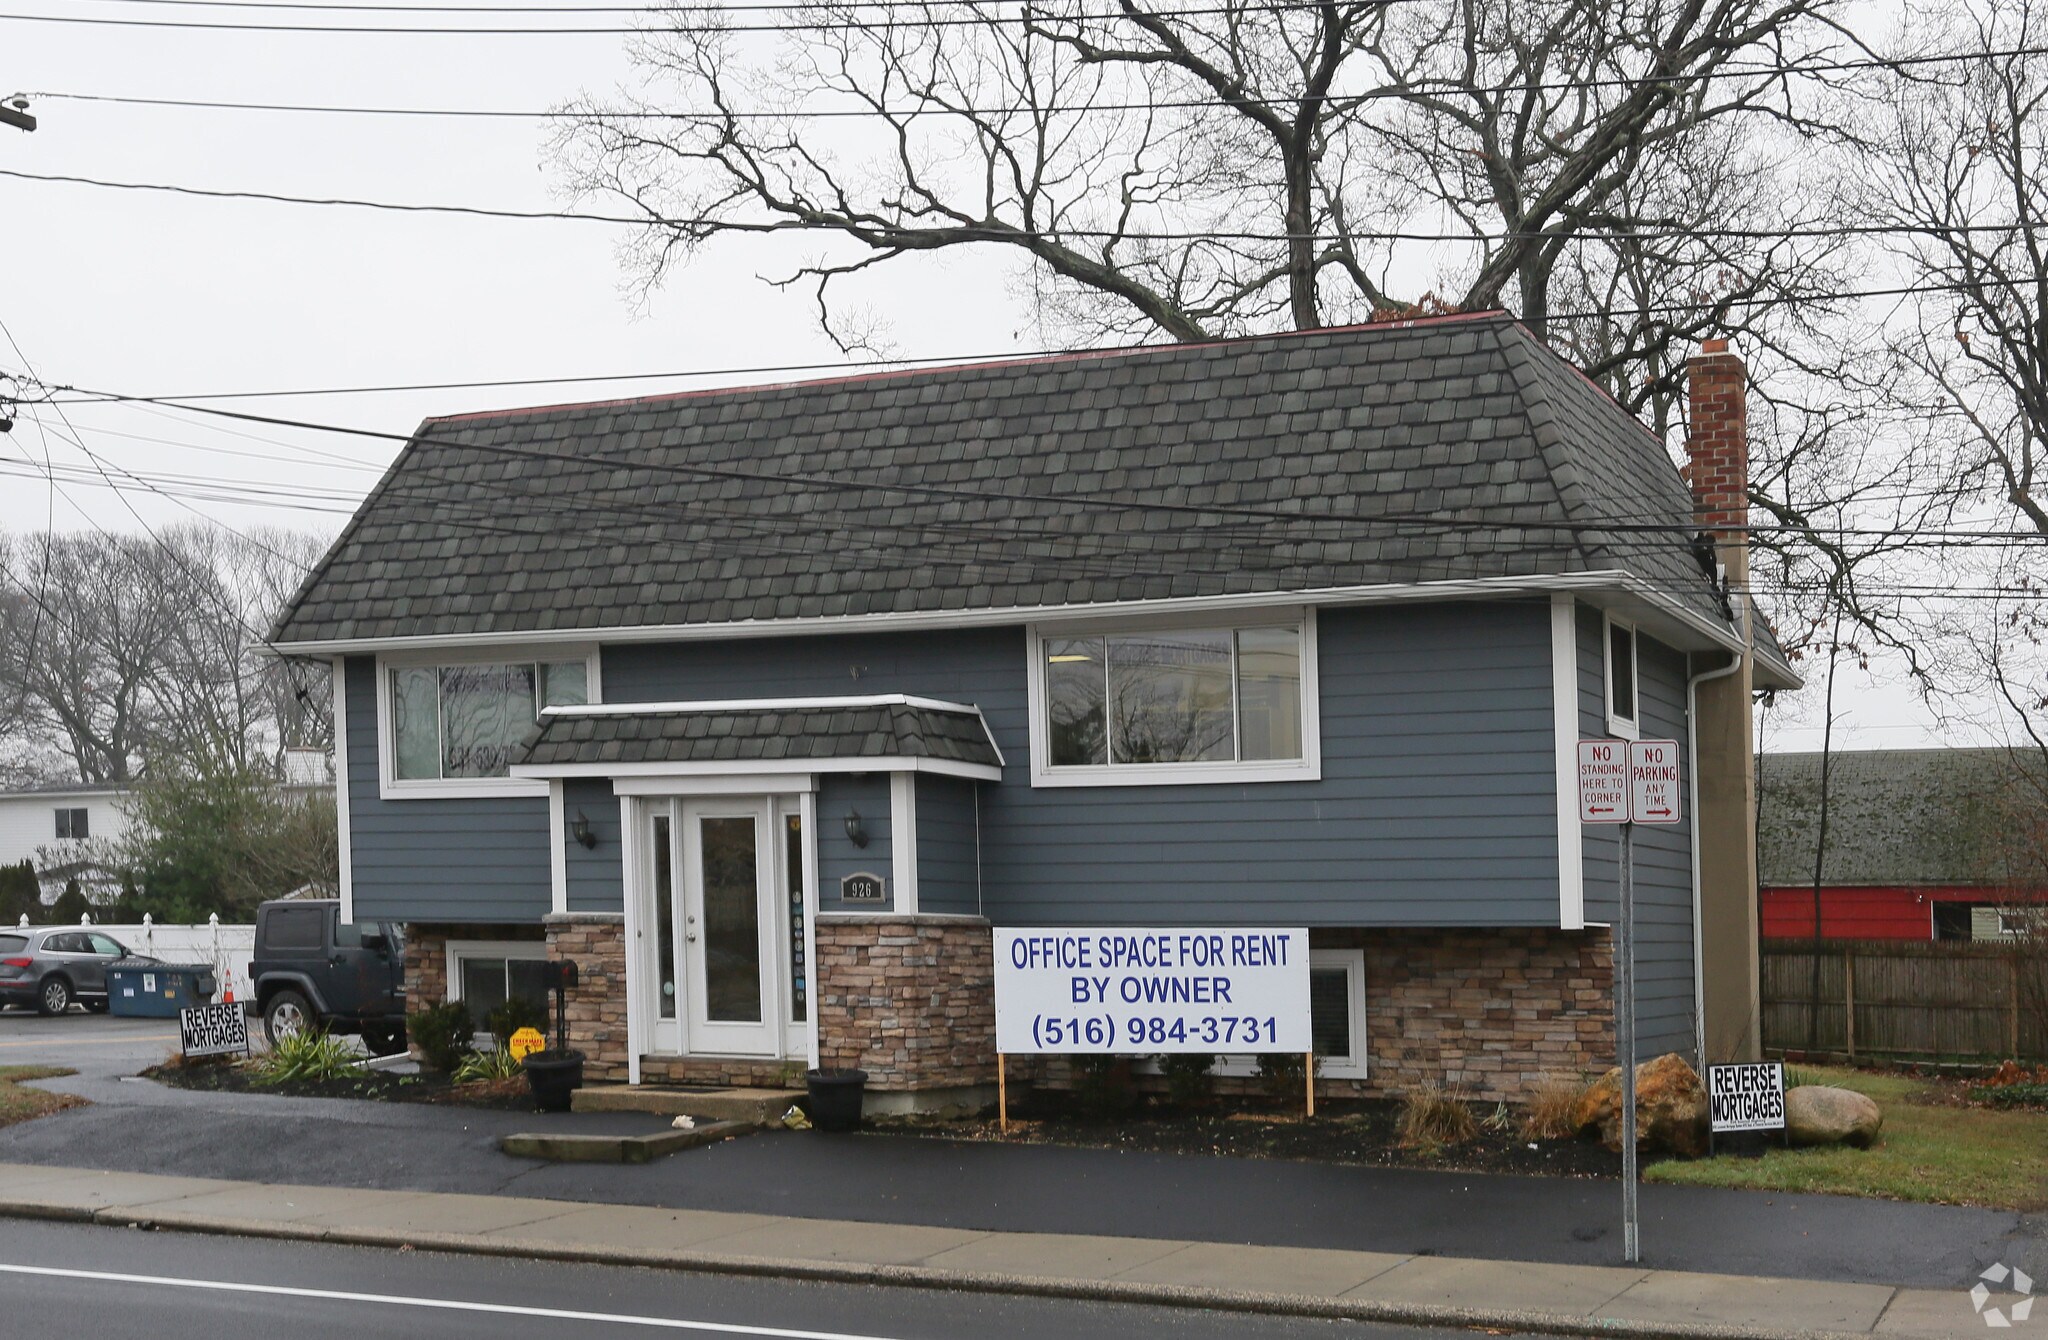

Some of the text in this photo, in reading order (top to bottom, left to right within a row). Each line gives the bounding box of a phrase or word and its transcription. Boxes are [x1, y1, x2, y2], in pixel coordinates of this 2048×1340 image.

[1592, 746, 1611, 761] NO
[1644, 748, 1663, 763] NO
[1581, 764, 1624, 775] STANDING
[1633, 766, 1676, 781] PARKING
[1582, 777, 1623, 789] HERE TO
[1645, 783, 1665, 794] ANY
[1584, 792, 1622, 803] CORNER
[1645, 795, 1667, 806] TIME
[852, 882, 871, 898] 926
[1011, 934, 1290, 970] OFFICE SPACE FOR RENT
[1071, 976, 1232, 1003] BY OWNER
[186, 1005, 239, 1028] REVERSE
[185, 1024, 244, 1048] MORTGAGES
[1032, 1014, 1277, 1049] (516) 984-3731
[1715, 1064, 1776, 1093] REVERSE
[1712, 1091, 1782, 1121] MORTGAGES
